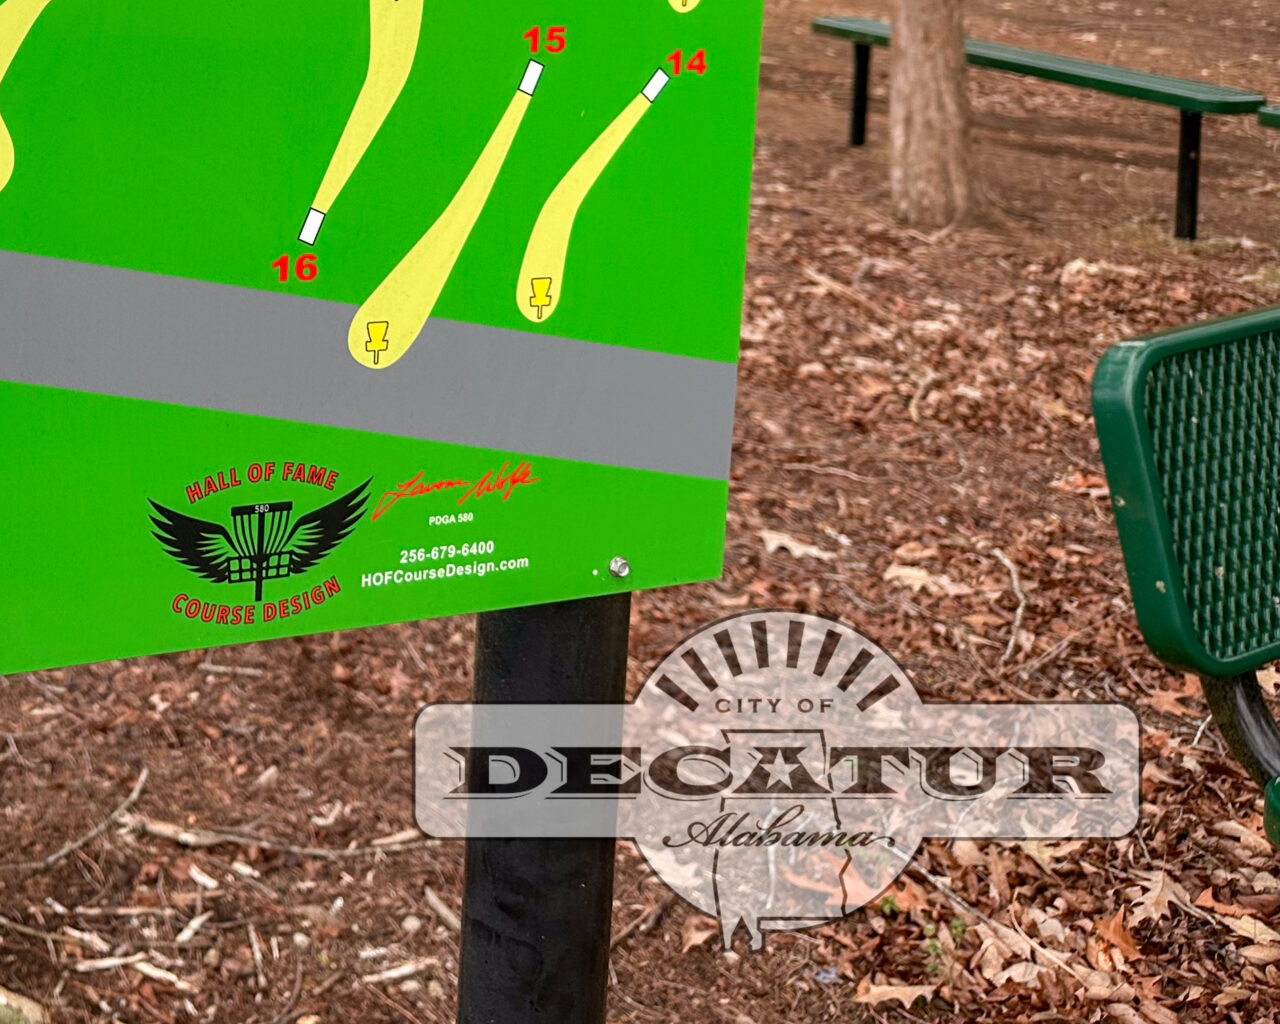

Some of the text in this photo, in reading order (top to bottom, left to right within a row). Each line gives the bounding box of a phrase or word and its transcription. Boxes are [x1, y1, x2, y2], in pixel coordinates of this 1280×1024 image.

[523, 27, 567, 54] 15
[667, 50, 707, 75] 14
[272, 254, 319, 282] 16
[184, 461, 340, 505] HALL OF FAME
[254, 504, 271, 514] 580
[428, 512, 474, 527] PDGA 580
[399, 540, 495, 564] 256-679-6400
[360, 555, 530, 588] HOFCourseDesign.com
[171, 576, 343, 626] COURSE DESIGN
